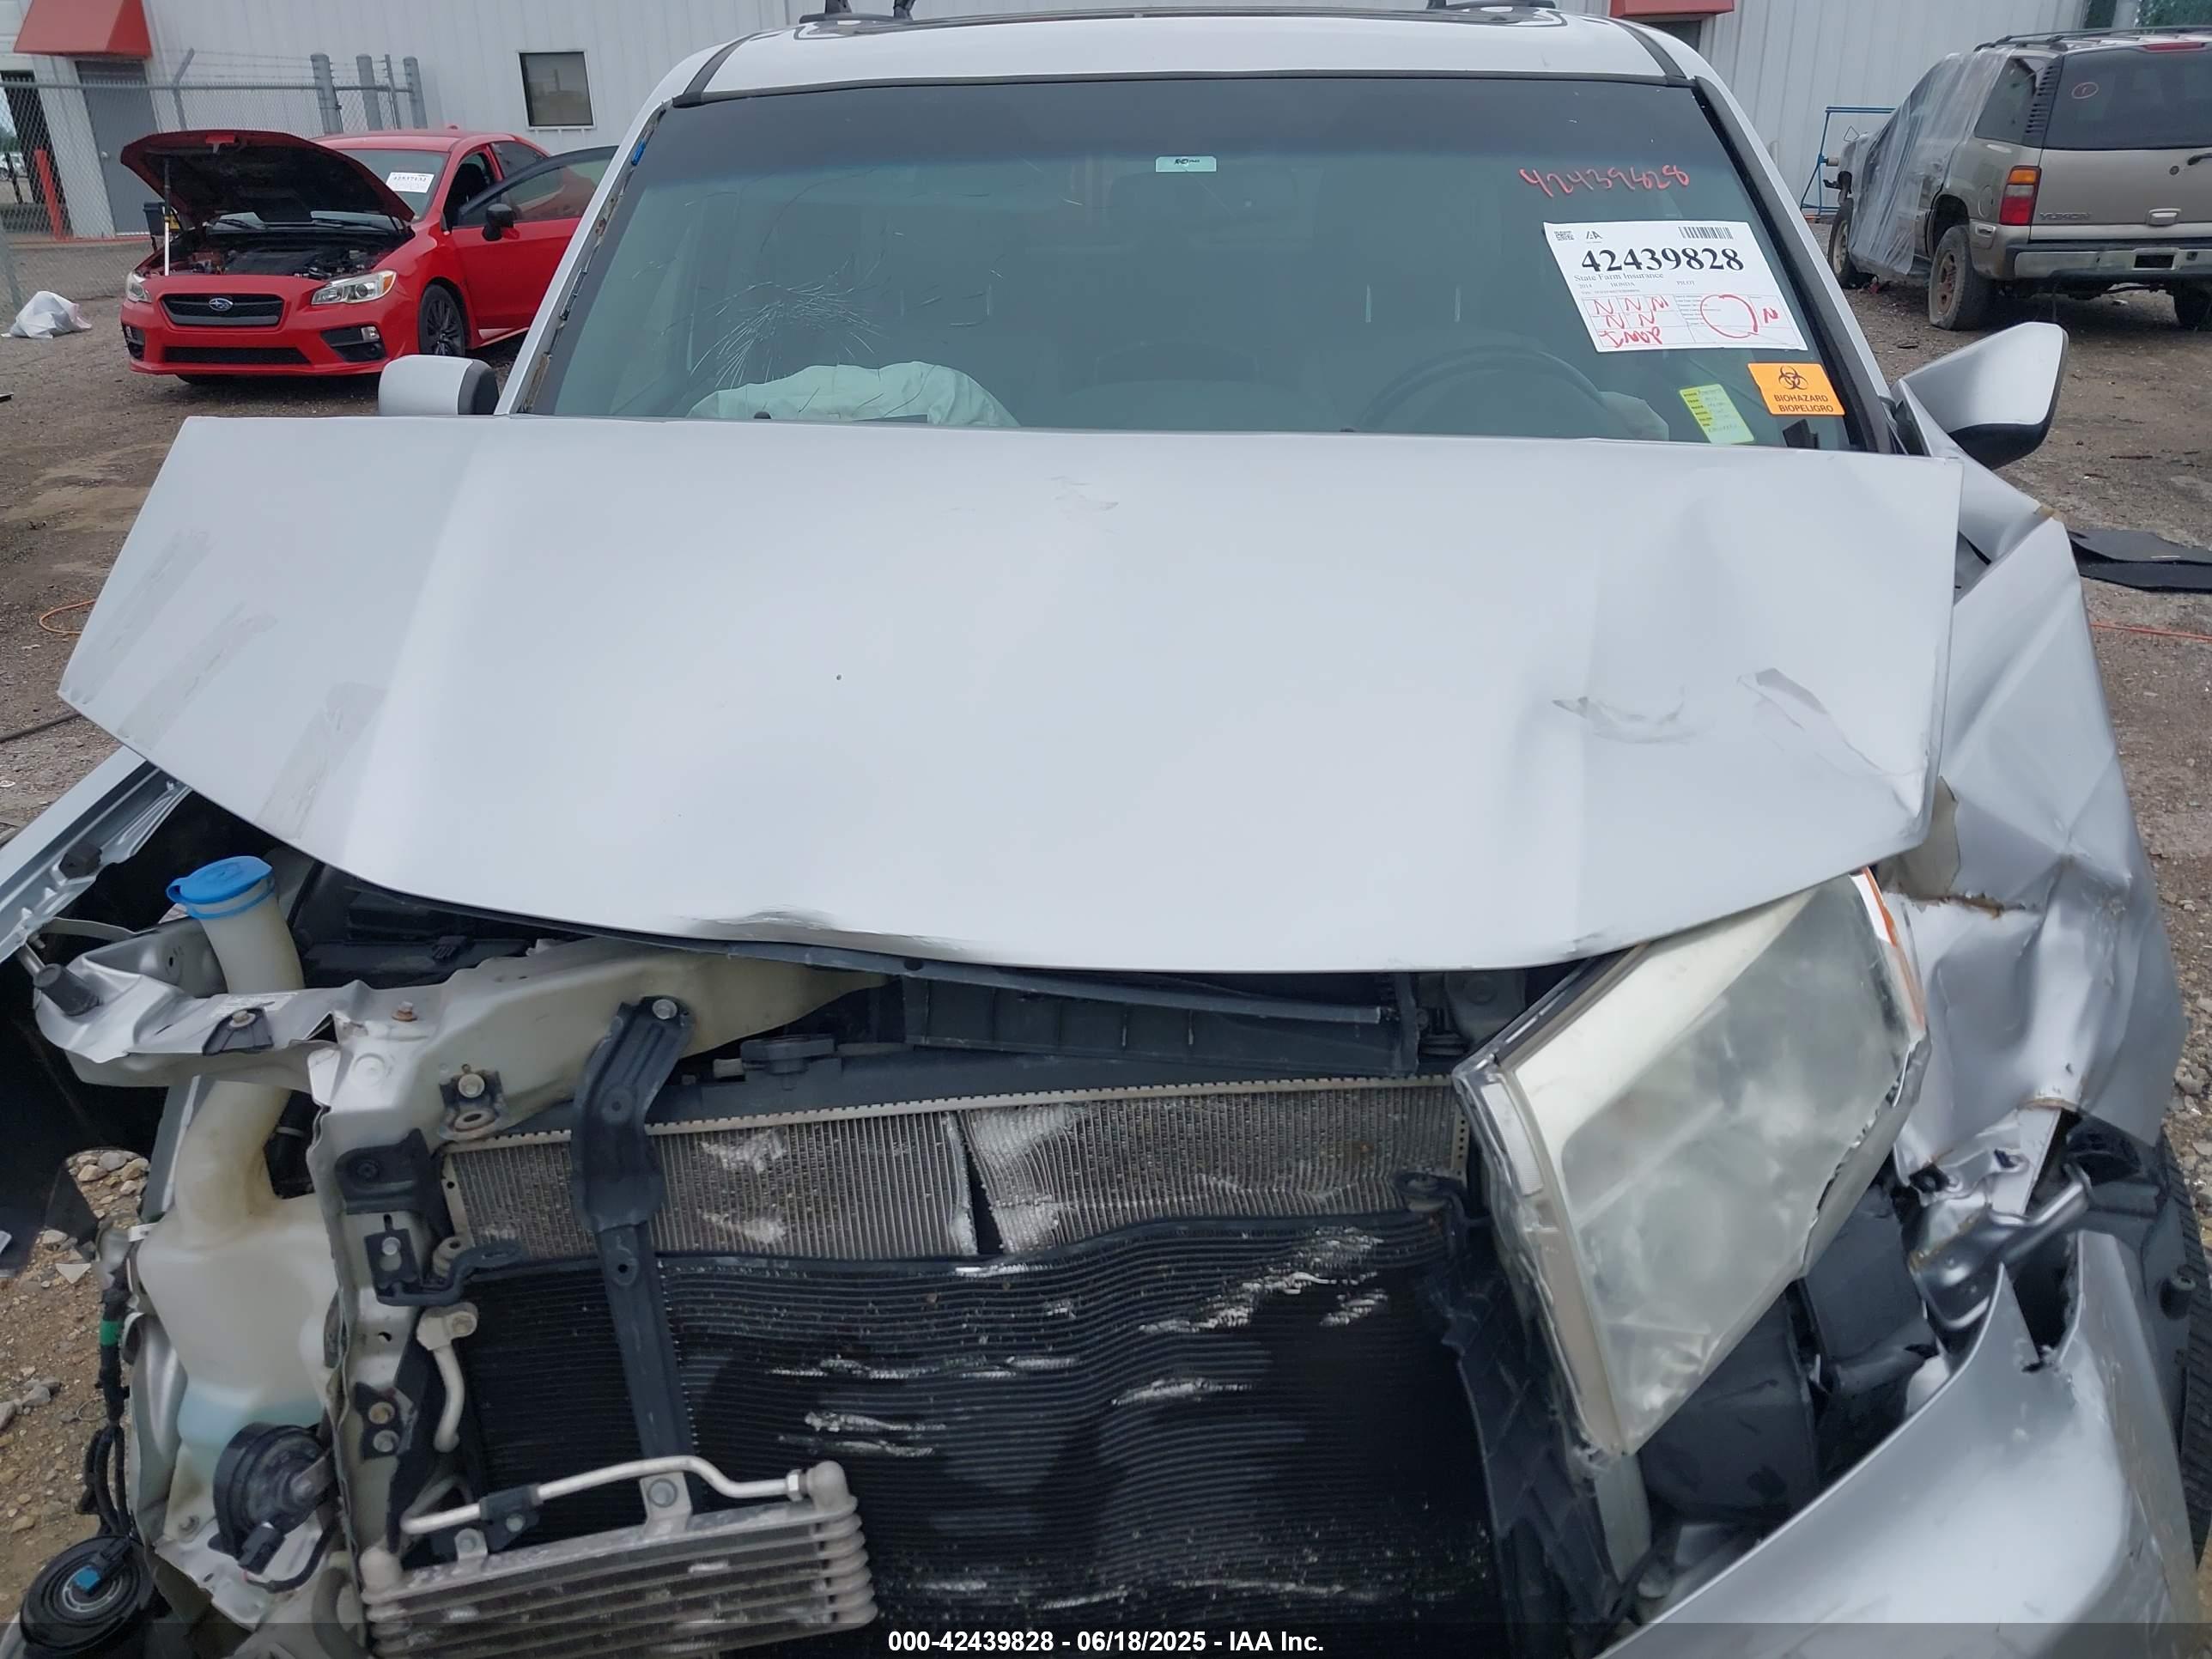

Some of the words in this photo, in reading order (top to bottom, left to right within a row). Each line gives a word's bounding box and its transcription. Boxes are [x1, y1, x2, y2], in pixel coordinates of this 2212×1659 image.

[1581, 247, 1745, 272] 42439828
[1573, 273, 1597, 283] State
[1598, 272, 1622, 281] Farm
[1623, 271, 1664, 280] Insurance
